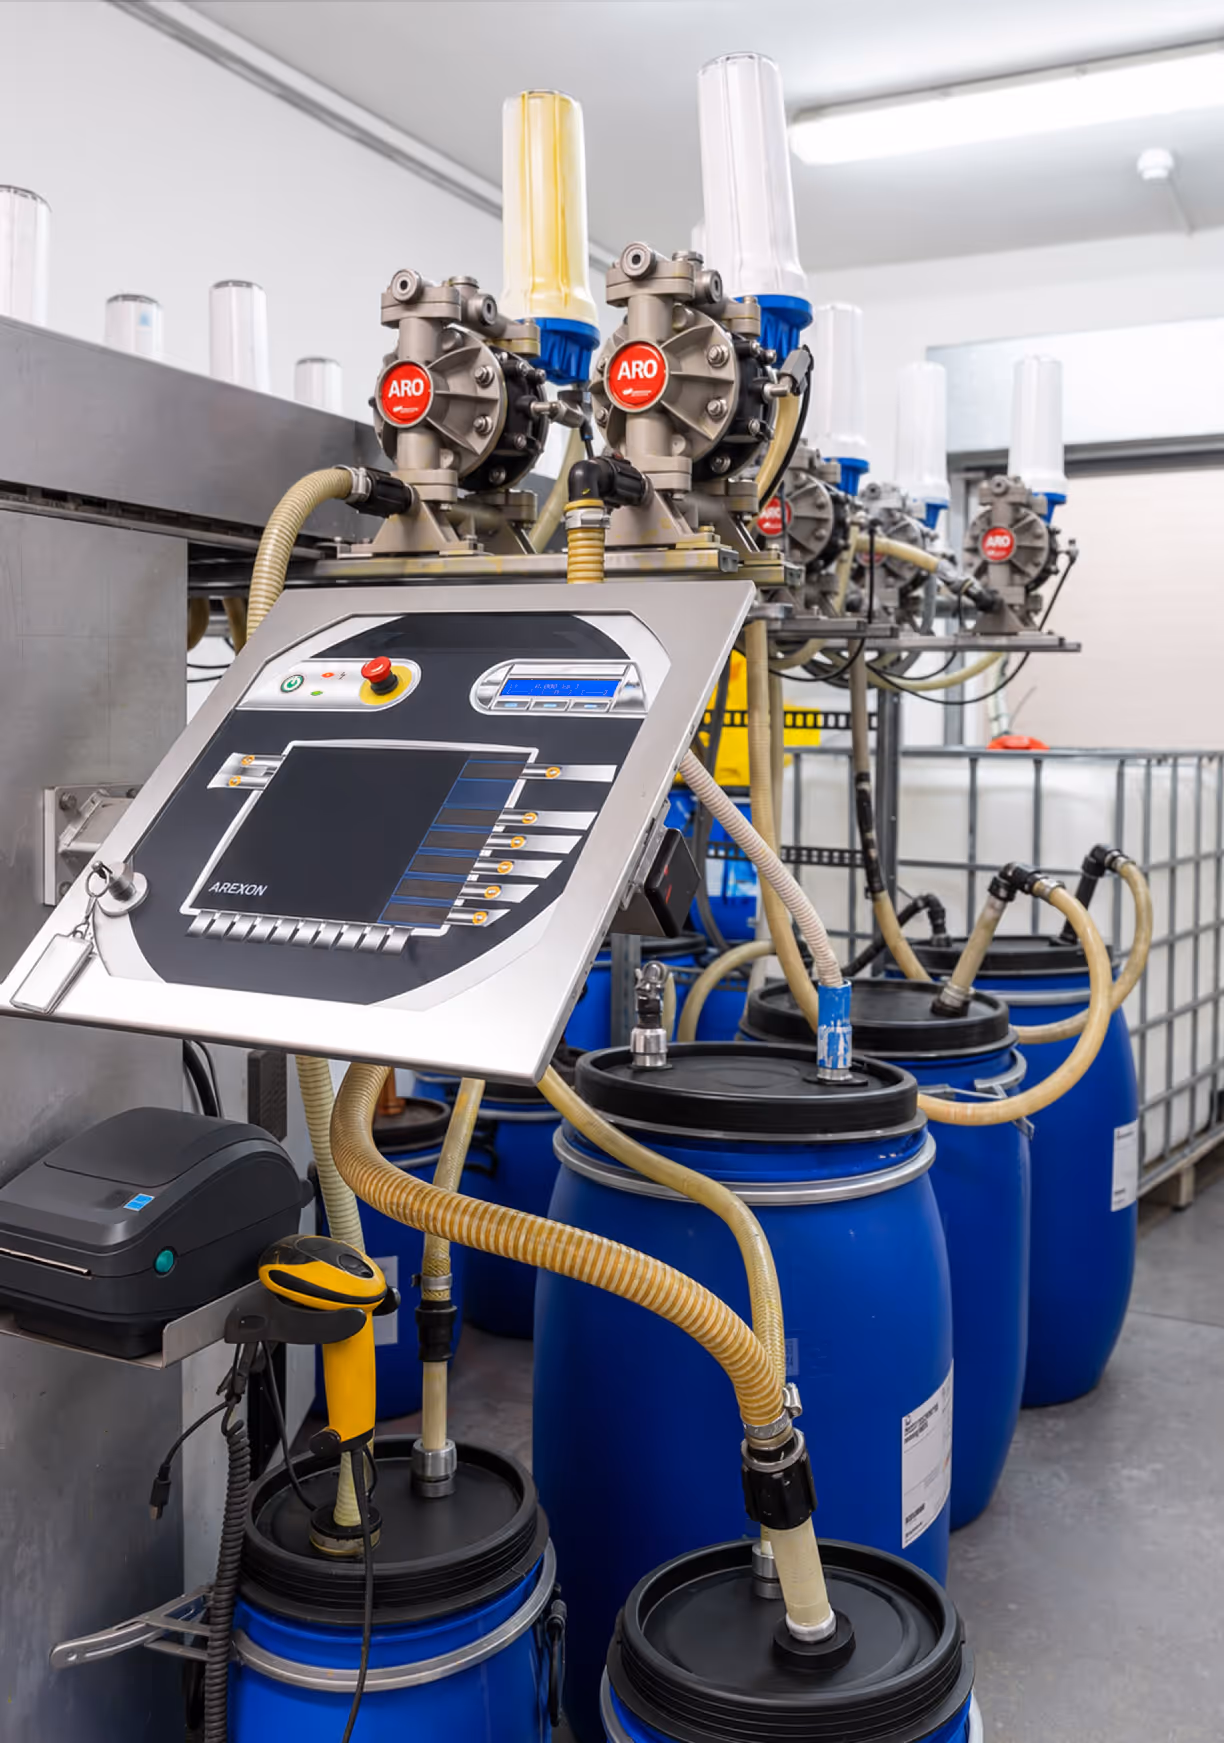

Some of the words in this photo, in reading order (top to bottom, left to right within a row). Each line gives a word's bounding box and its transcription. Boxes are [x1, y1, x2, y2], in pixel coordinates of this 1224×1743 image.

[617, 359, 658, 381] ARO
[388, 379, 424, 398] ARO
[986, 535, 1011, 547] ARO
[208, 881, 268, 896] AREXON
